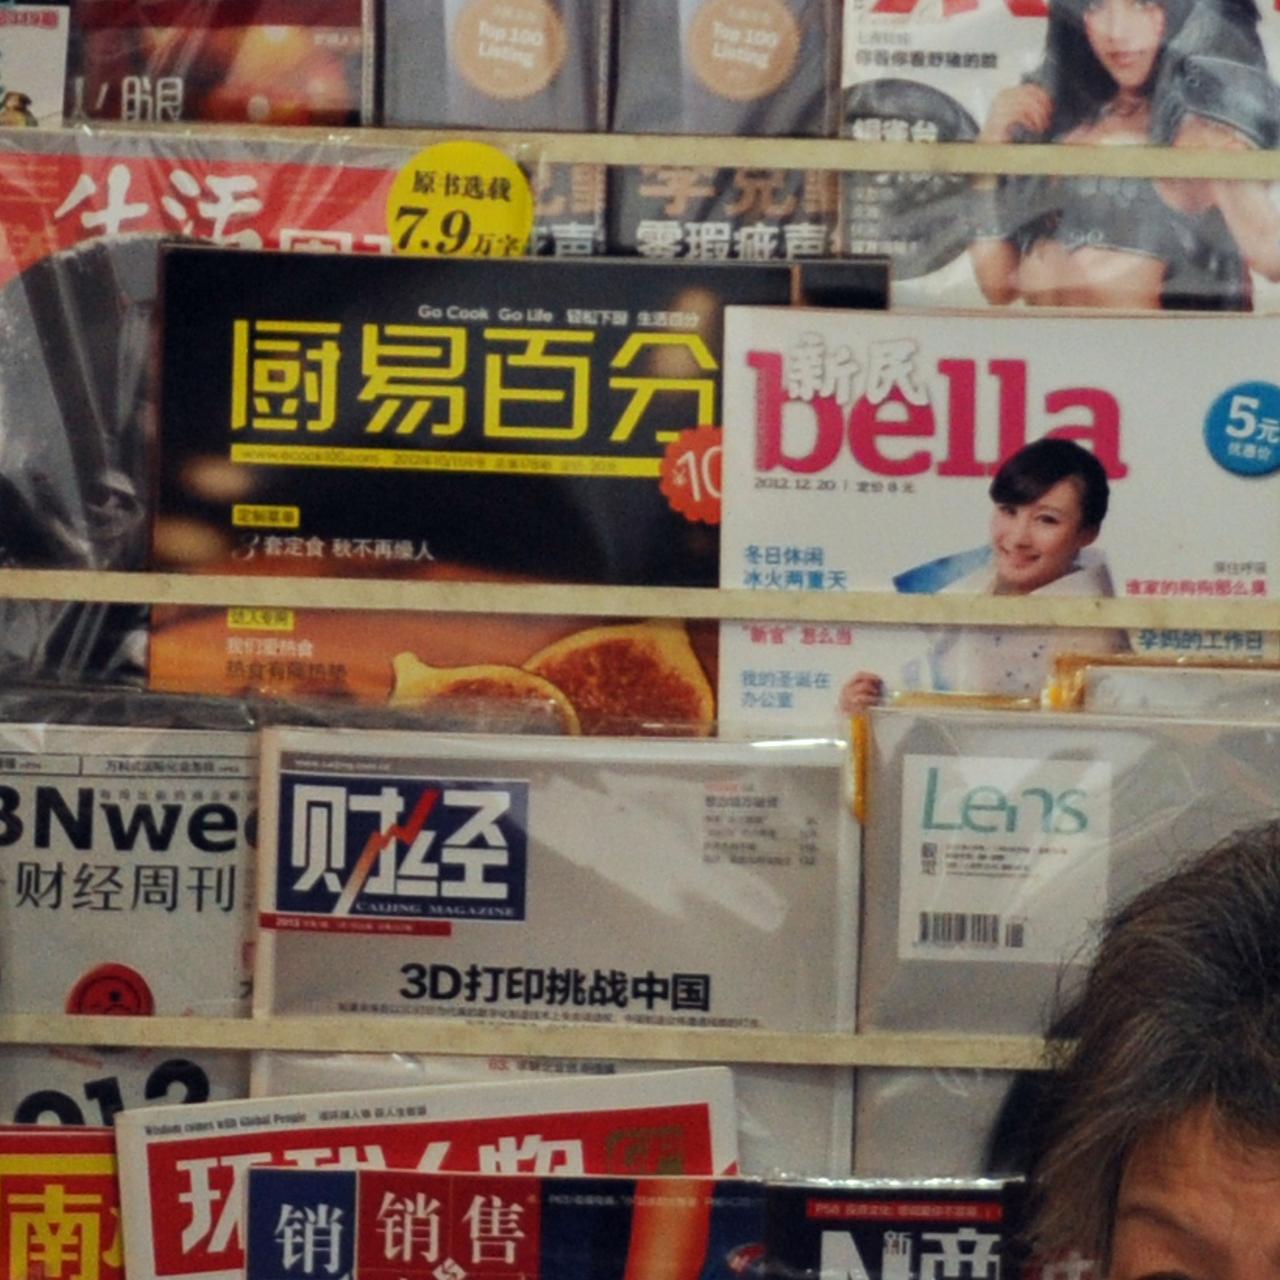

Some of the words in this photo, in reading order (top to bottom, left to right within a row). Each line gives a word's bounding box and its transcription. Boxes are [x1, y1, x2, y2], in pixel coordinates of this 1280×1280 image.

[477, 22, 512, 46] Top
[712, 22, 746, 46] Top
[412, 169, 513, 204] 原书选载
[418, 304, 442, 321] Go
[446, 304, 489, 322] Cook
[498, 306, 524, 324] Go
[528, 306, 553, 324] Life
[231, 319, 719, 442] 厨易百分
[745, 349, 1129, 480] bella
[743, 544, 825, 568] 冬日休闲
[742, 569, 848, 592] 冰火两重天
[1137, 628, 1265, 652] 孕妈的工作日
[740, 661, 831, 687] 我的圣诞在
[740, 686, 795, 710] 办公室
[921, 766, 1090, 836] Lens
[291, 783, 511, 898] 财经
[355, 900, 423, 915] CAIJING
[429, 904, 516, 918] MAGAZINE
[398, 962, 711, 1014] 3D打印挑战中国
[375, 1190, 526, 1266] 销售
